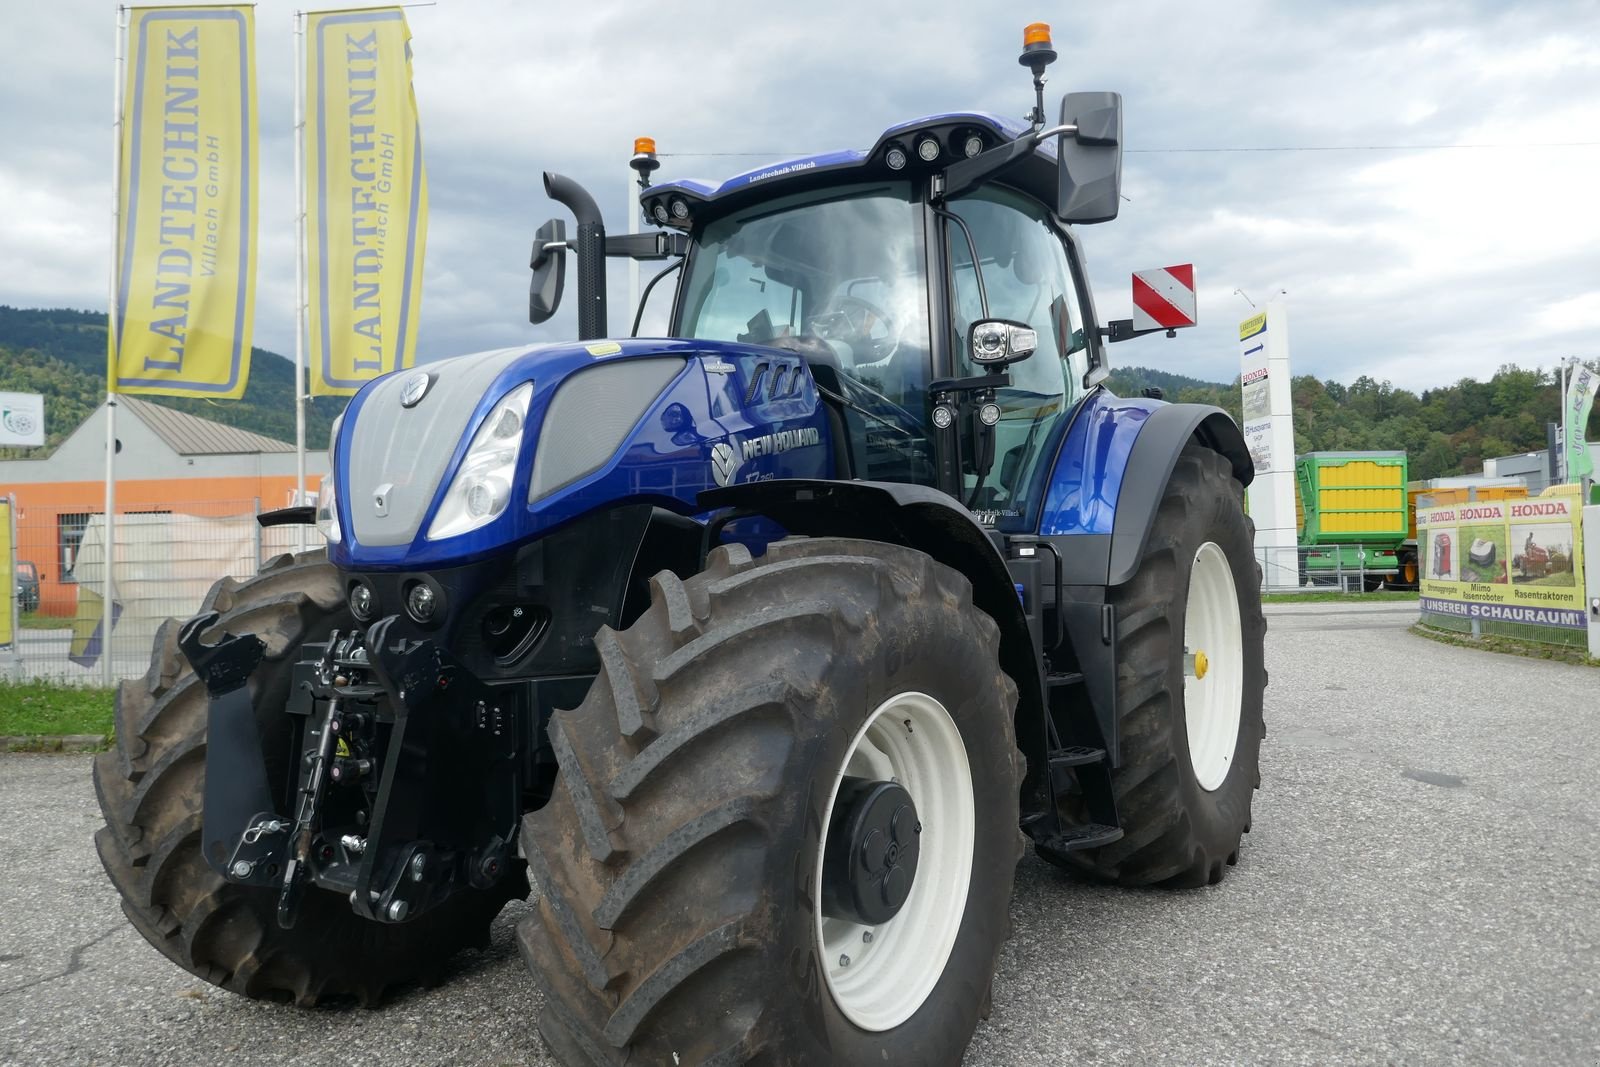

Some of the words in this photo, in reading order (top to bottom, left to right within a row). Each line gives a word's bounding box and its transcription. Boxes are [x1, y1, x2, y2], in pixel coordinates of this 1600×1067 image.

[205, 135, 220, 198] GmbH
[377, 133, 395, 193] GmbH
[749, 160, 816, 183] Landtechnik-Villach
[144, 26, 199, 374] LANDTECHNIK
[345, 28, 382, 376] LANDTECHNIK
[200, 208, 218, 277] Villach
[1243, 367, 1268, 382] HONDA
[742, 435, 772, 461] NEW
[772, 427, 819, 456] HOLLAND
[1430, 511, 1456, 523] HONDA
[1460, 507, 1503, 520] HONDA
[1511, 502, 1568, 517] HONDA
[1462, 592, 1504, 602] Rasenroboter
[1470, 583, 1491, 592] Miimo
[1514, 589, 1574, 601] Rasentraktoren
[1426, 599, 1468, 615] UNSEREN
[1470, 605, 1580, 626] SCHAURAUM!
